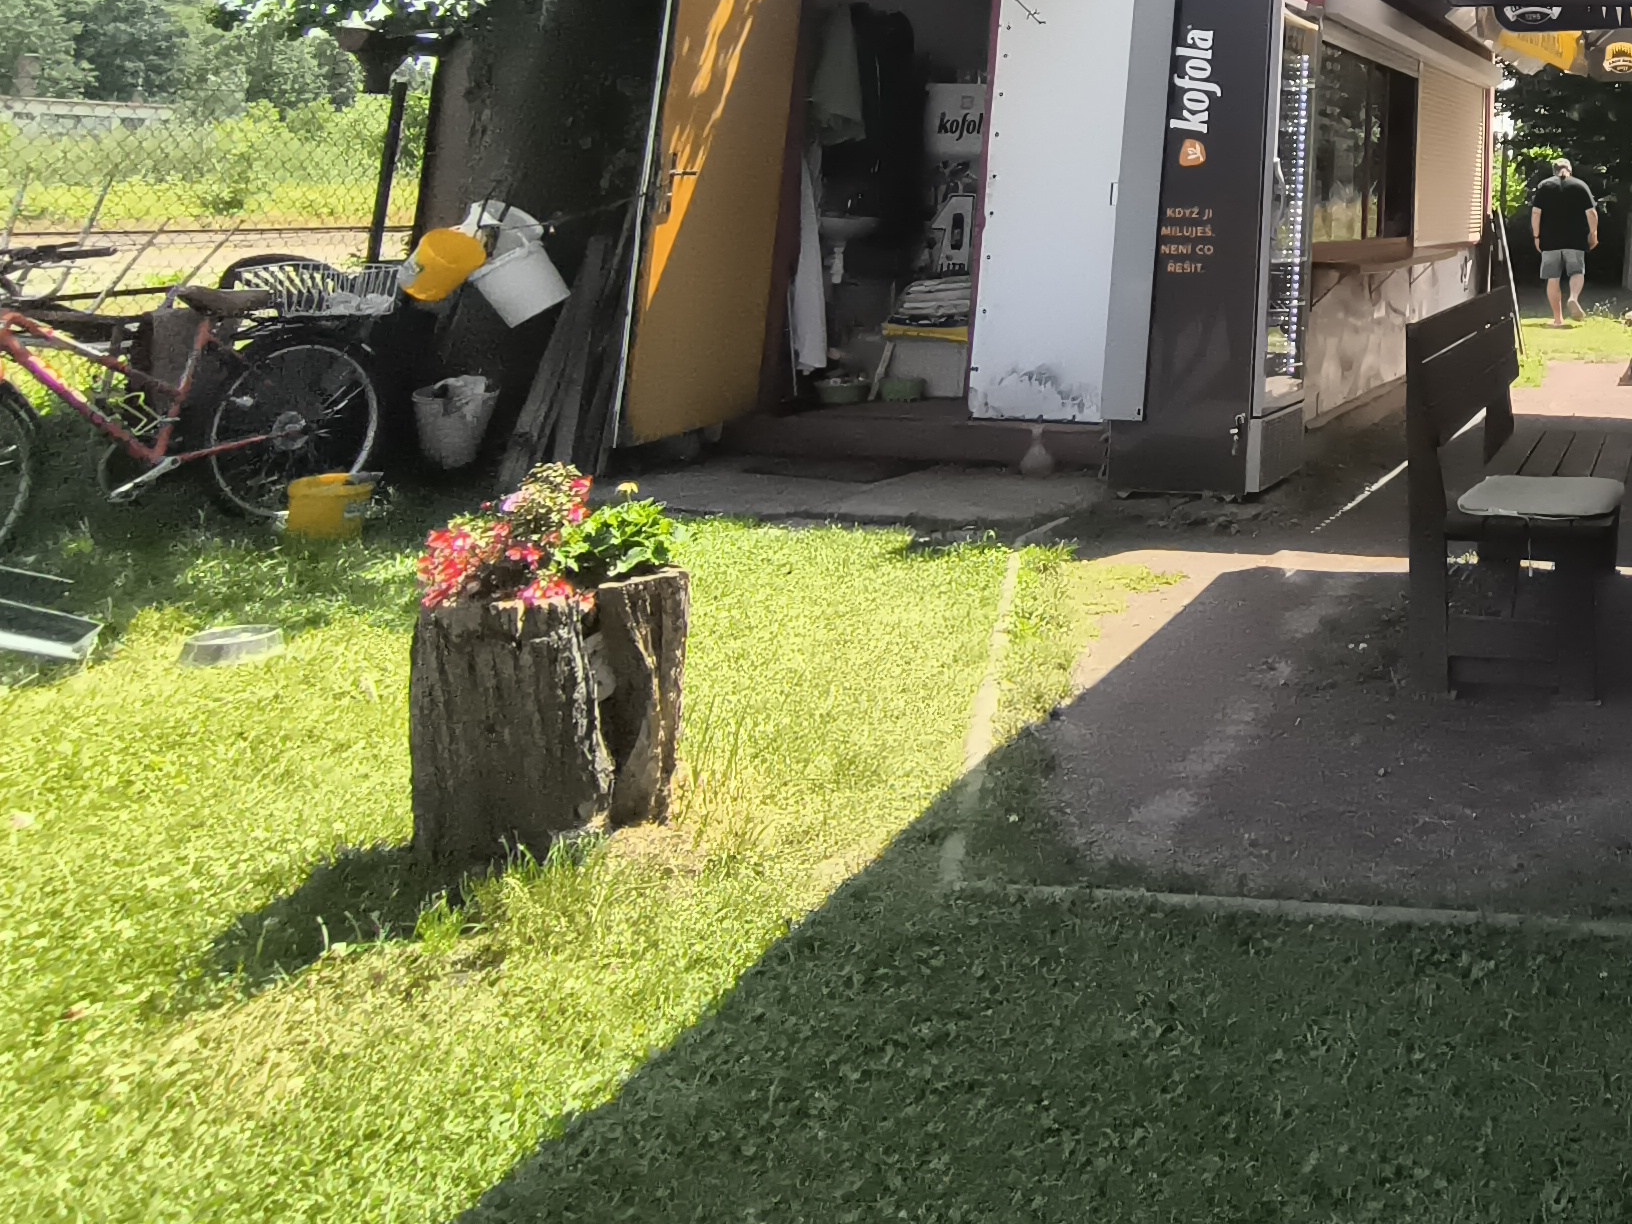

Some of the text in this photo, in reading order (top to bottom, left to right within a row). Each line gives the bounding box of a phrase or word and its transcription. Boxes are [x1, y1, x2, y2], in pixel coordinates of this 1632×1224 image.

[1170, 29, 1222, 134] kofola
[937, 112, 984, 141] kofol
[1166, 206, 1213, 220] KDYŽ JI
[1160, 243, 1214, 255] NENÍ CO
